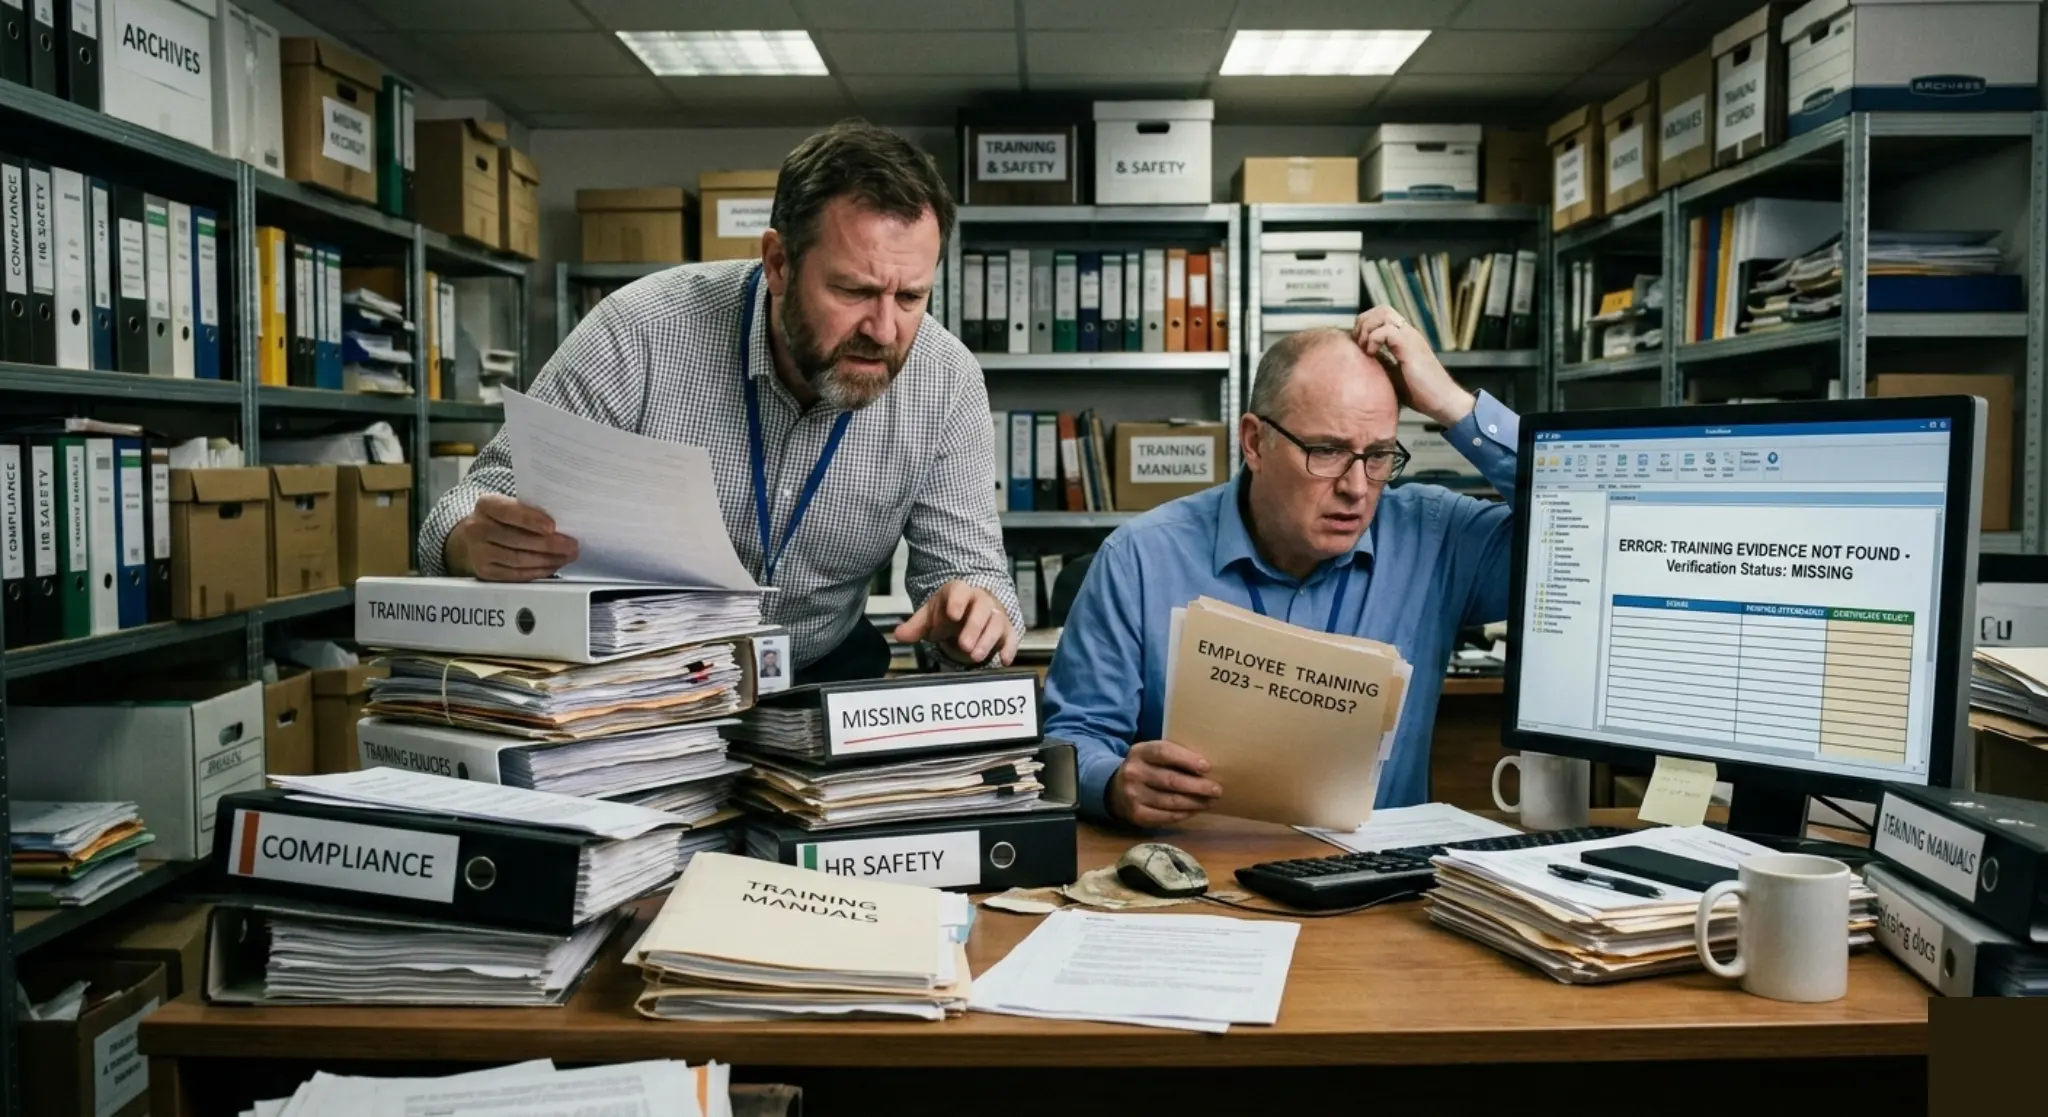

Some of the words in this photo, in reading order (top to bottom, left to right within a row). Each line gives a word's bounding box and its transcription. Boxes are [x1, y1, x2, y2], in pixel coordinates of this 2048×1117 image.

[123, 23, 201, 75] ARCHIVES
[985, 140, 1056, 154] TRAINING
[986, 160, 999, 174] &
[1002, 160, 1055, 174] SAFETY
[1115, 159, 1128, 174] &
[1137, 443, 1207, 457] TRAINING
[1137, 463, 1208, 476] MANUALS
[1670, 540, 1734, 556] TRAINING
[1736, 542, 1808, 558] EVIDENCE
[1811, 544, 1843, 559] NOT
[1846, 545, 1901, 561] FOUND
[1666, 558, 1737, 575] Verification
[1740, 562, 1787, 577] Status:
[1791, 564, 1854, 580] MISSING
[369, 600, 437, 623] TRAINING
[441, 605, 506, 628] POLICIES
[1197, 639, 1287, 677] EMPLOYEE
[1295, 665, 1380, 698] TRAINING
[1209, 666, 1251, 689] 2023
[1267, 682, 1358, 714] RECORDS?
[842, 704, 925, 730] MISSING
[930, 695, 1027, 723] RECORDS?
[262, 834, 435, 879] COMPLIANCE
[825, 857, 857, 877] HR
[863, 849, 945, 876] SAFETY
[1926, 833, 1977, 876] MANUALS
[742, 893, 879, 924] MANUALS
[747, 880, 877, 912] TRAINING
